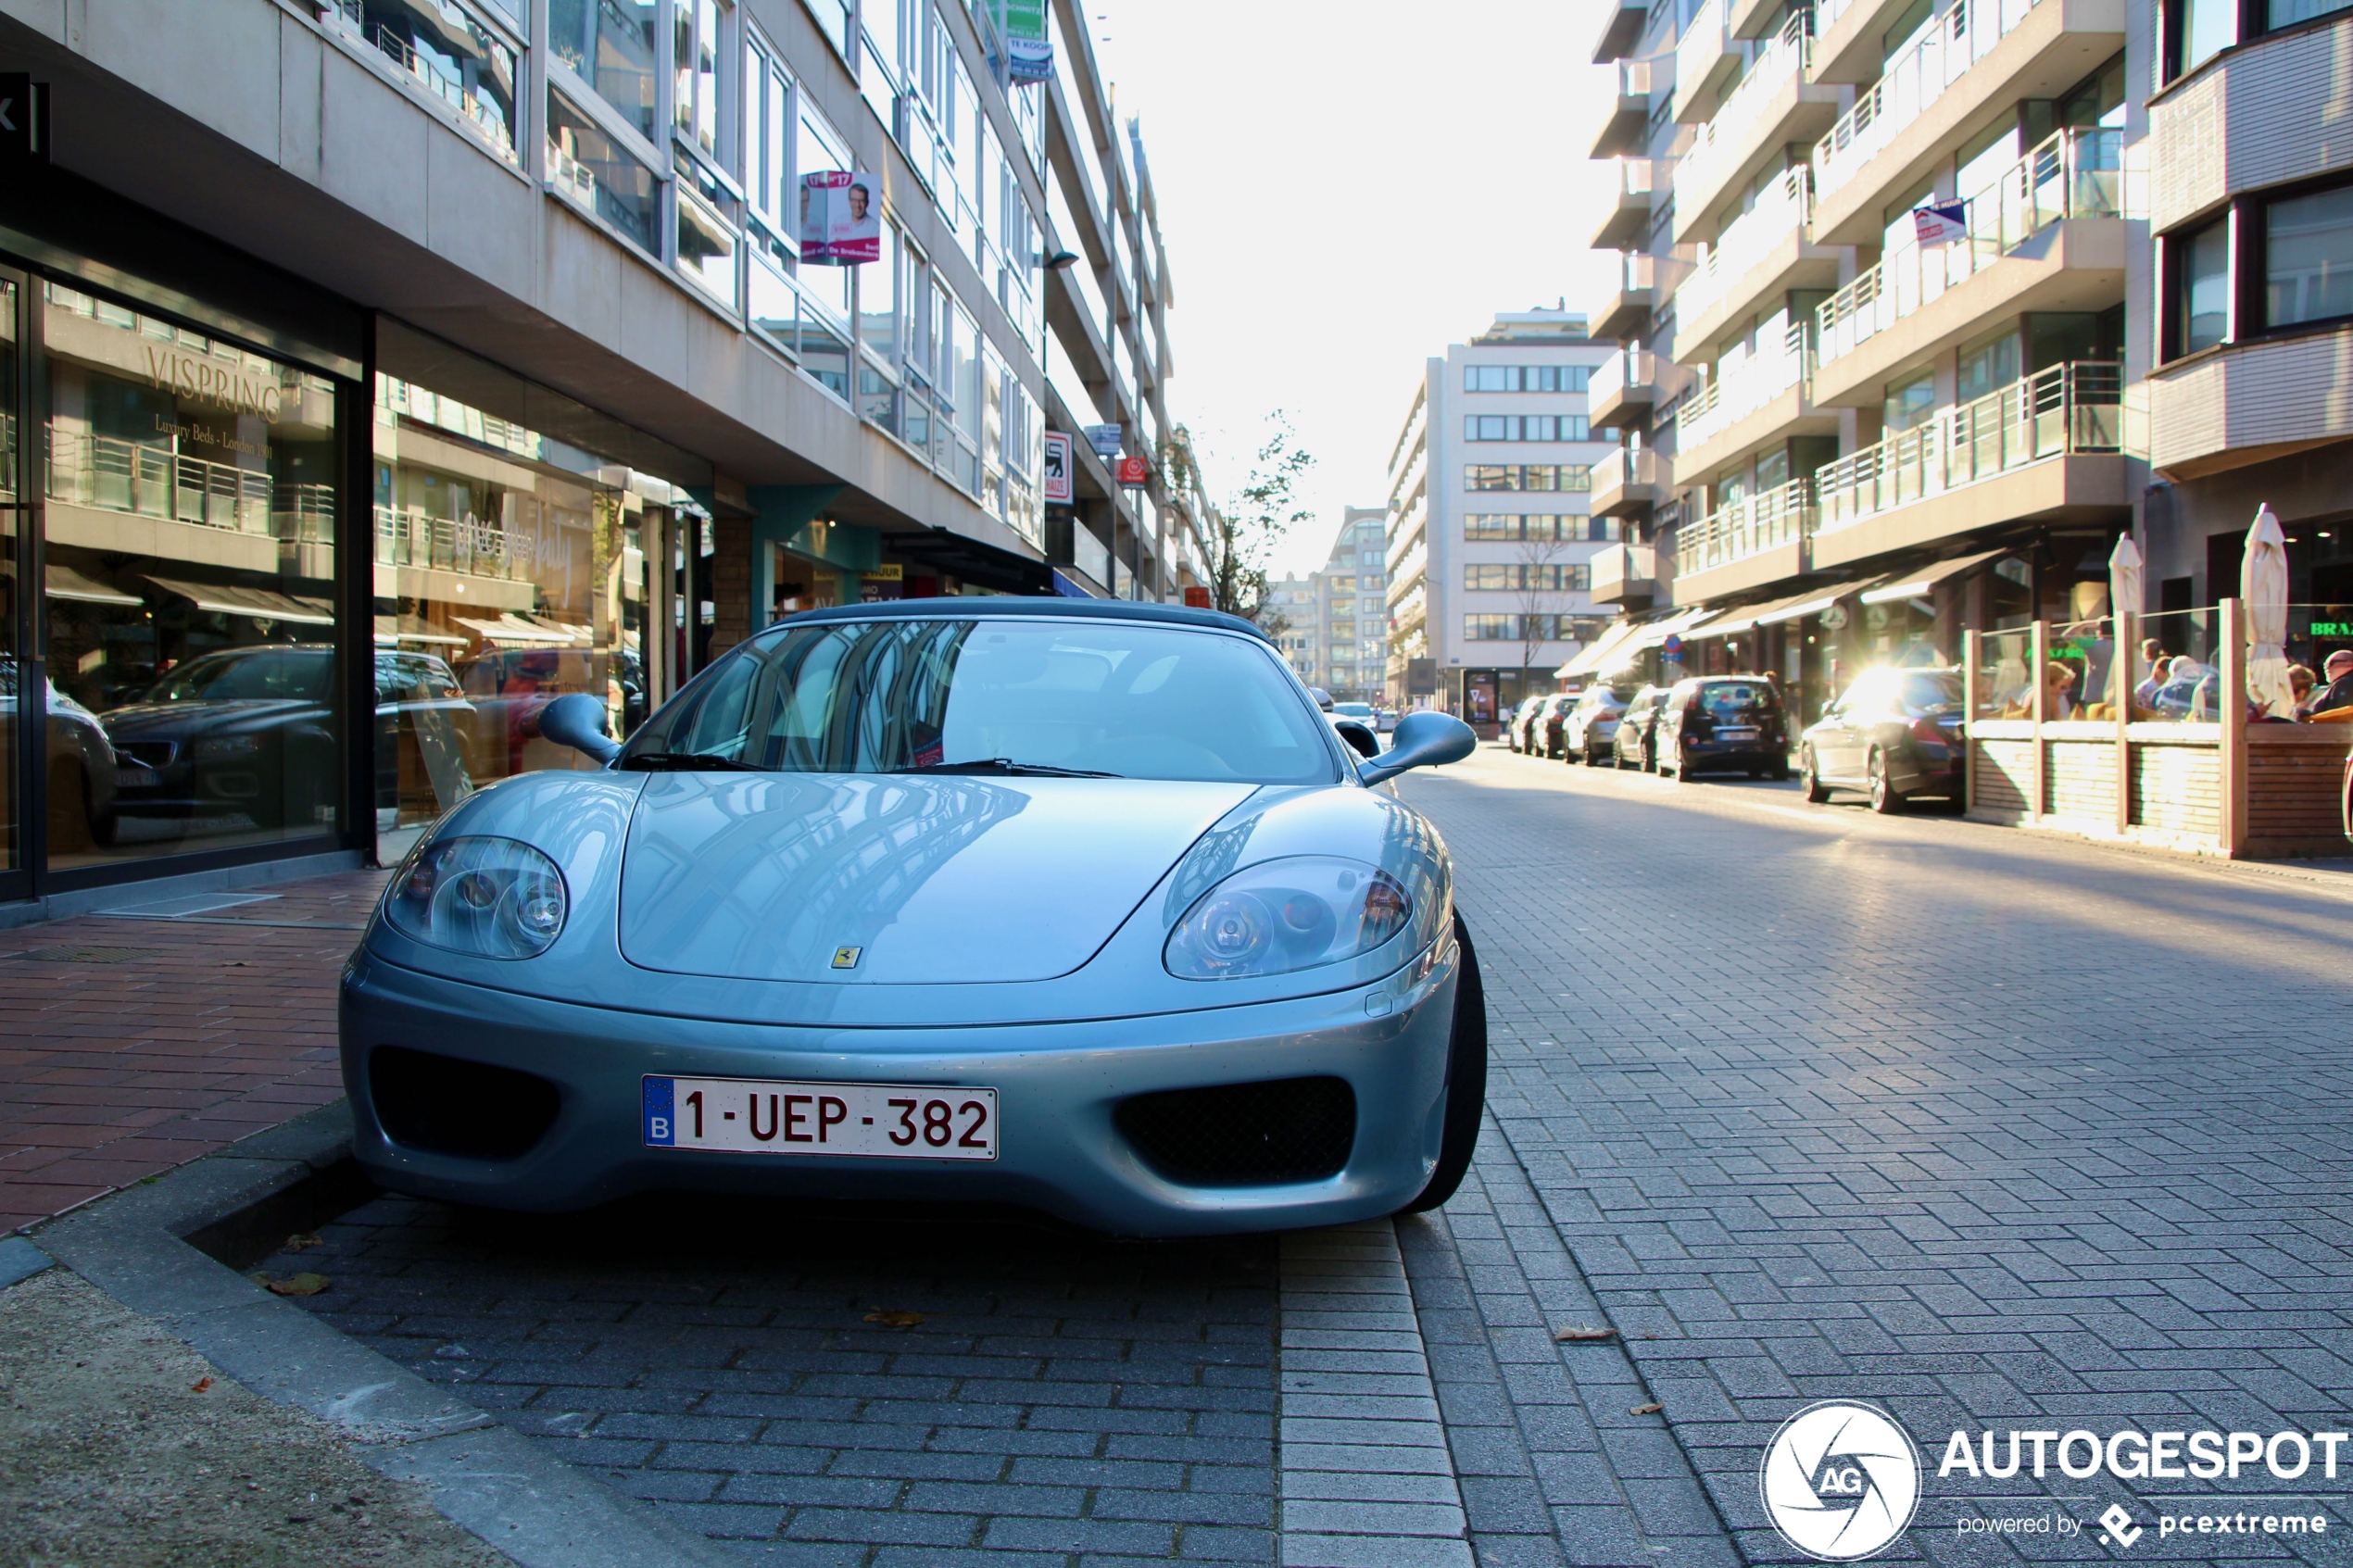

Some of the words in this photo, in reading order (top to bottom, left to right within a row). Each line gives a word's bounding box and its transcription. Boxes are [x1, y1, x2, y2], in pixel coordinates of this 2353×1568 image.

[1024, 42, 1050, 51] KOOP
[148, 345, 281, 424] VISPRING
[156, 413, 191, 444] Luxury
[193, 423, 214, 445] Beds
[222, 432, 255, 456] London
[650, 1117, 669, 1139] B
